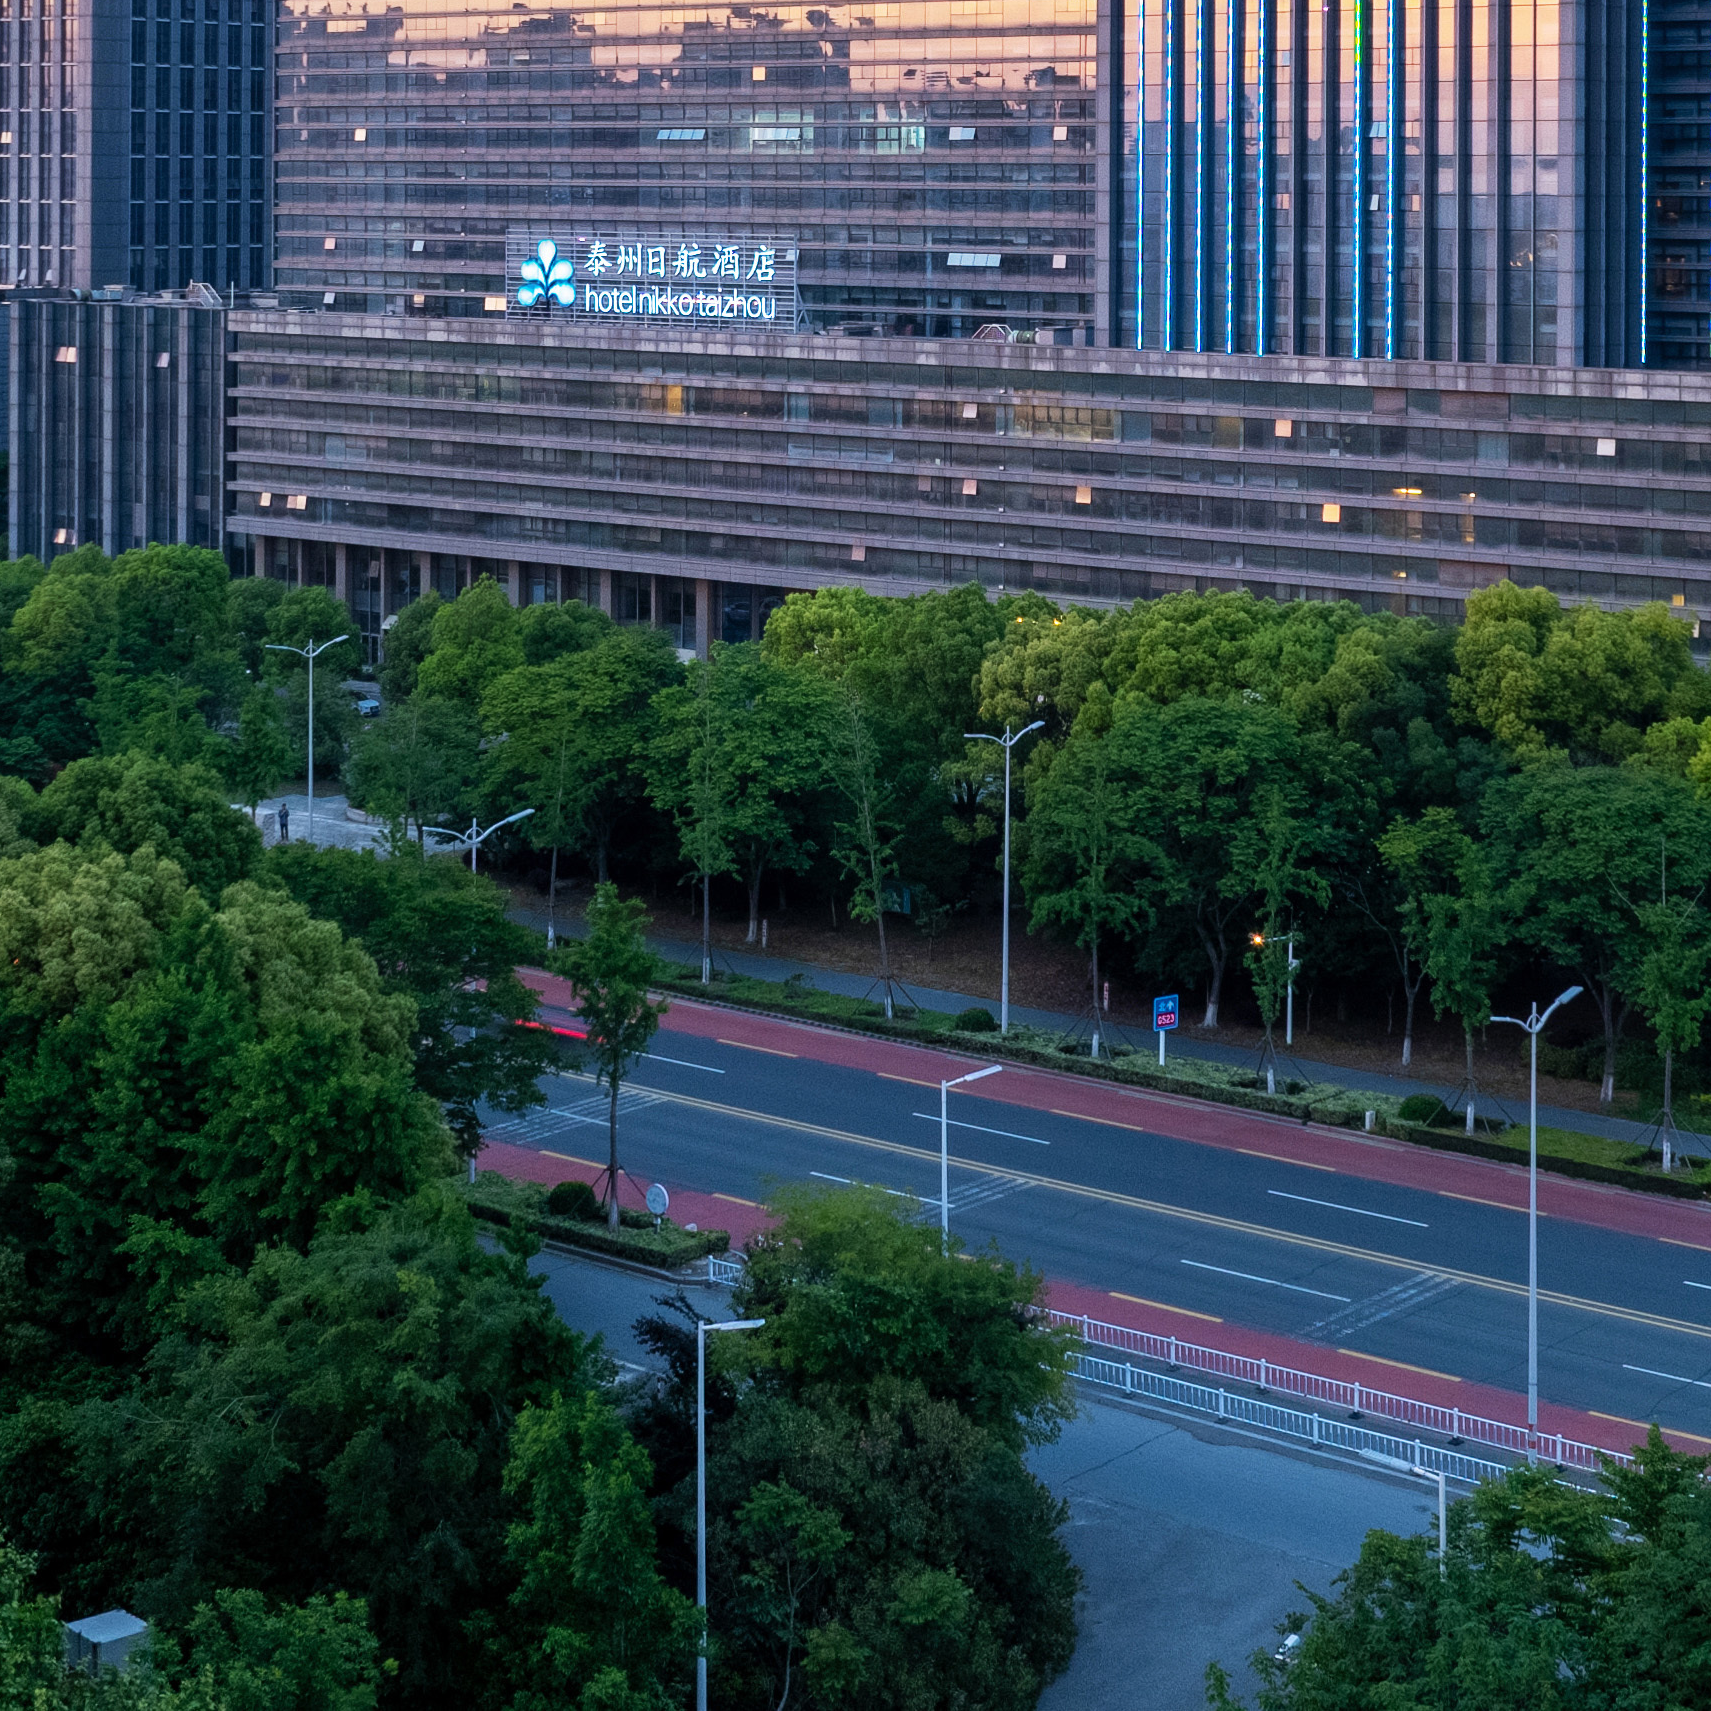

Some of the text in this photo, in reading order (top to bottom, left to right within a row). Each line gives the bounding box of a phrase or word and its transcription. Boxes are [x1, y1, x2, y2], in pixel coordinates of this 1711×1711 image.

[583, 240, 776, 281] 泰州日航酒店
[585, 284, 776, 319] hotel nikko taizhou
[1157, 1013, 1175, 1025] G523
